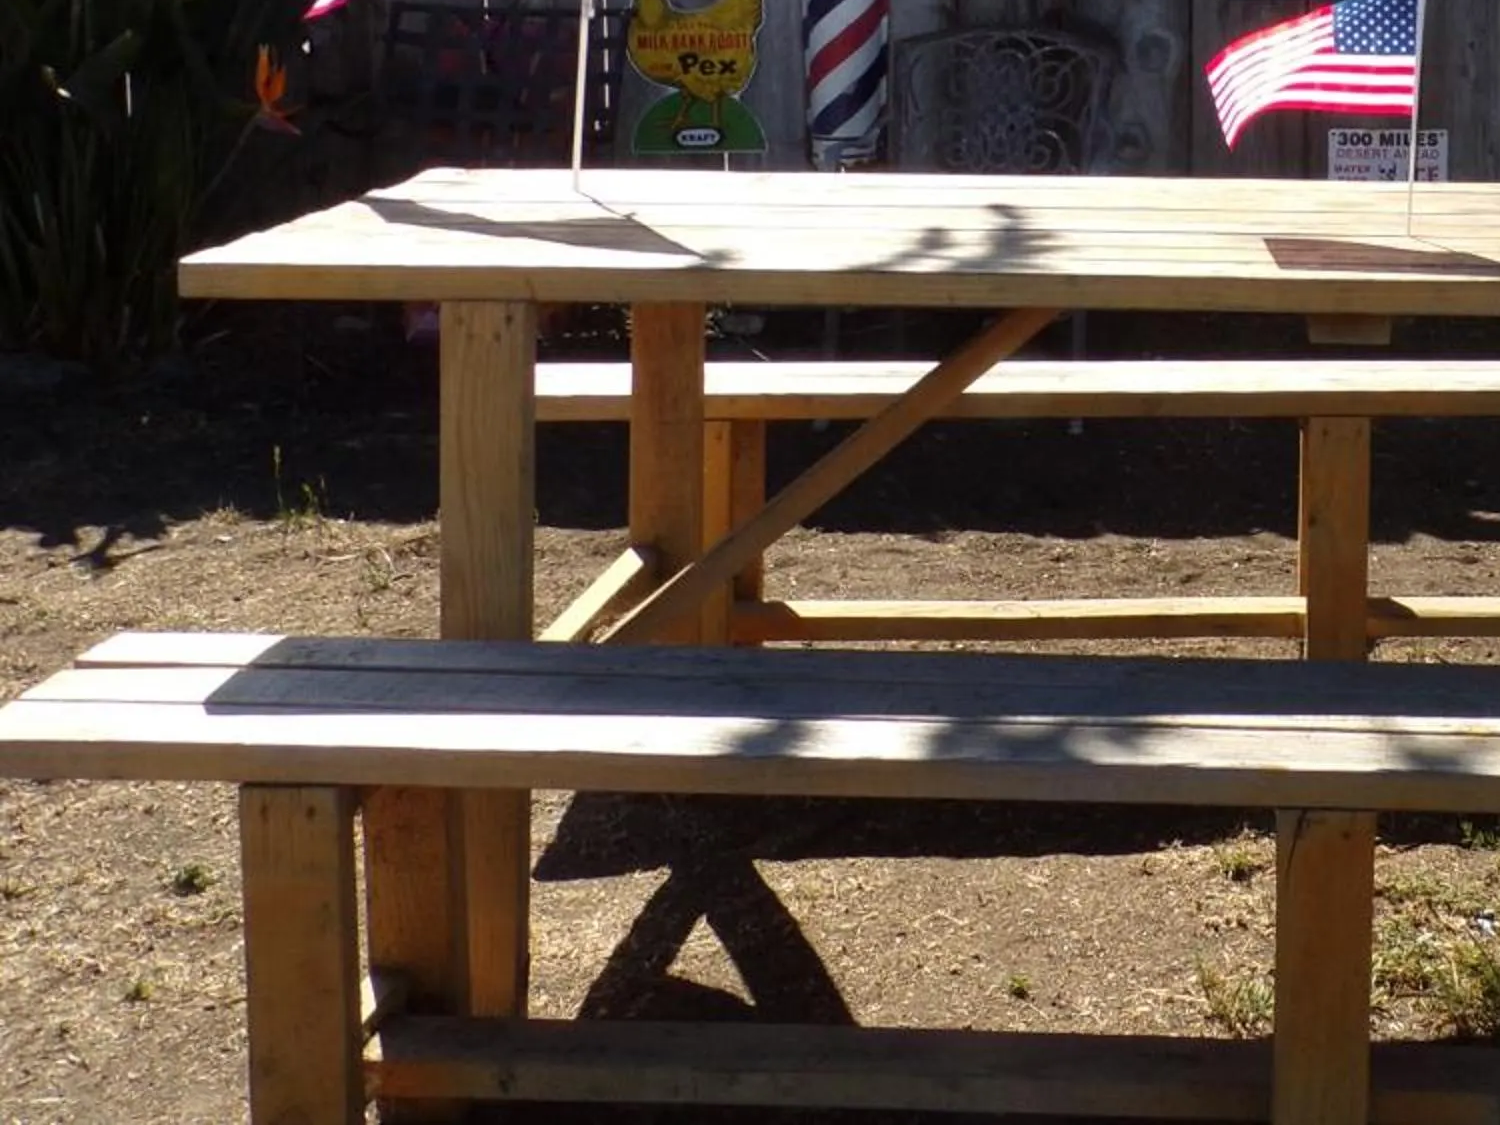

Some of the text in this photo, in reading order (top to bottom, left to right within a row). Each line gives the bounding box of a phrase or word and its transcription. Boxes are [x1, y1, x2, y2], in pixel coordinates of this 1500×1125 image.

[679, 52, 737, 75] Pex
[1337, 132, 1439, 147] 300 MILES
